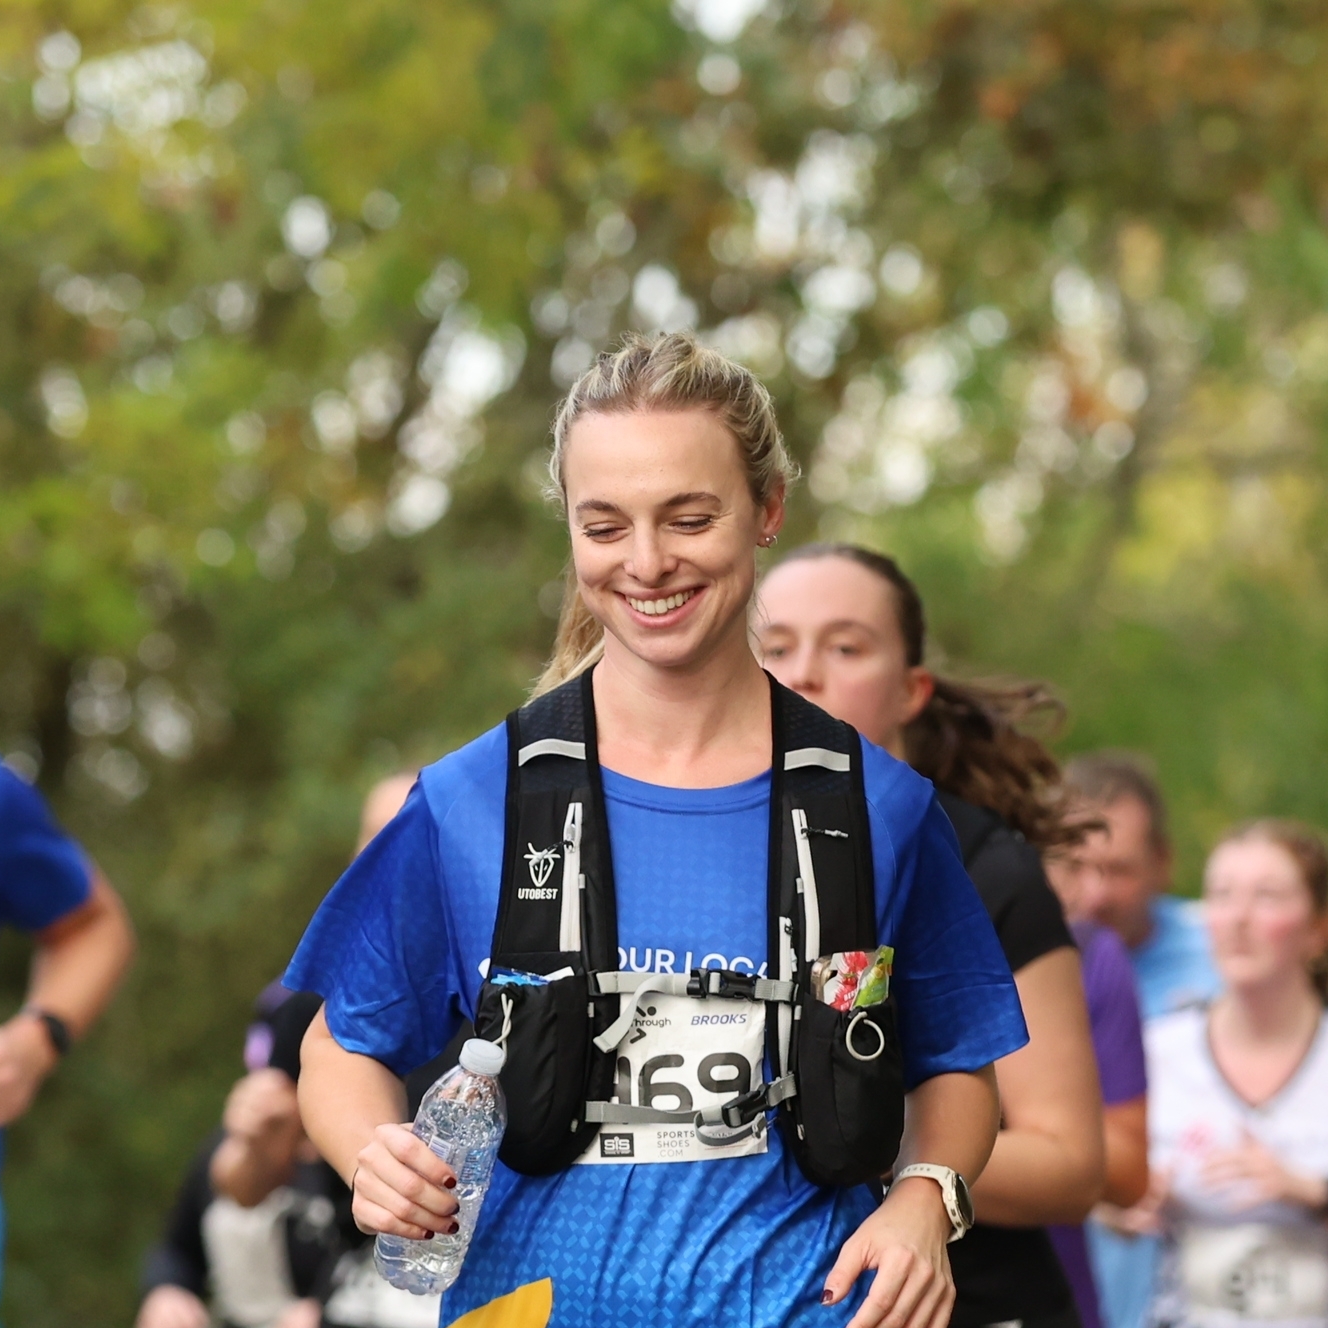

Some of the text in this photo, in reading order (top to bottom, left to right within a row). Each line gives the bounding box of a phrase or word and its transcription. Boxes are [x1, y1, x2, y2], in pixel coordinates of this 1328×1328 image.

[517, 887, 559, 900] UTOBEST
[690, 1013, 747, 1026] BROOKS
[657, 1131, 695, 1139] SPORTS
[657, 1139, 690, 1148] SHOES
